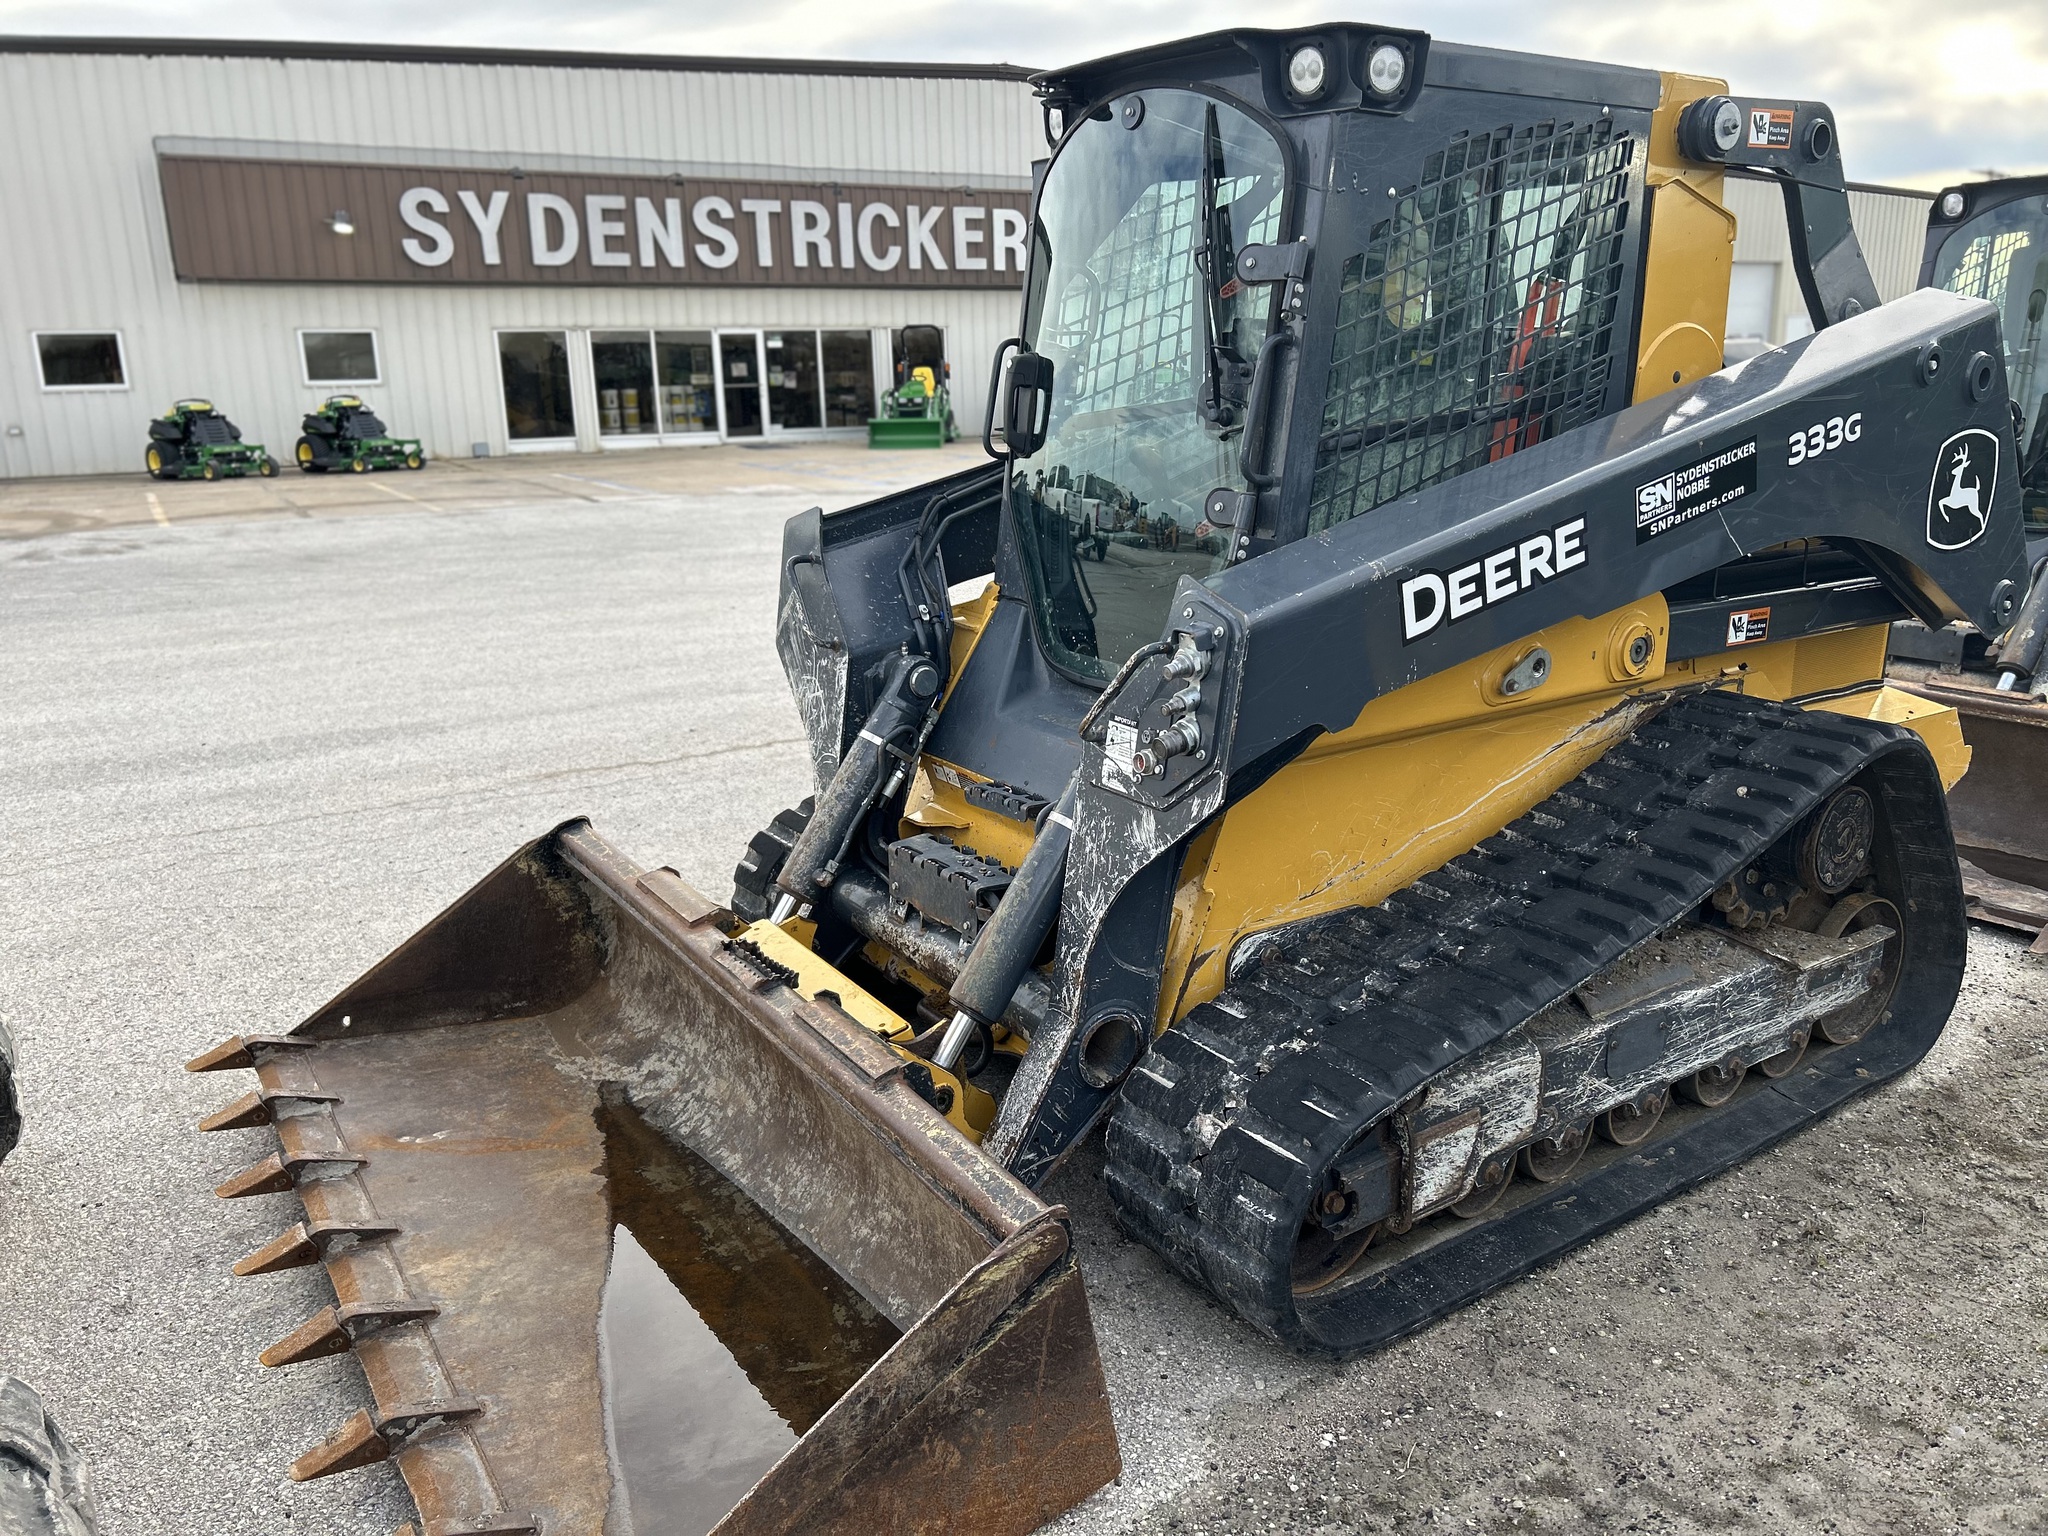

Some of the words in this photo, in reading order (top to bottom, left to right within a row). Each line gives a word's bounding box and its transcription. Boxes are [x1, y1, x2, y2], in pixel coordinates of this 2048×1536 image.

[399, 186, 1027, 272] SYDENSTRICKER
[1676, 441, 1756, 487] SYDENSTRICKER
[1788, 412, 1862, 466] 333G
[1639, 502, 1673, 523] PARTNERS
[1650, 485, 1745, 536] SNPartners.com
[1676, 476, 1710, 502] NOBBE
[1402, 517, 1586, 640] DEERE
